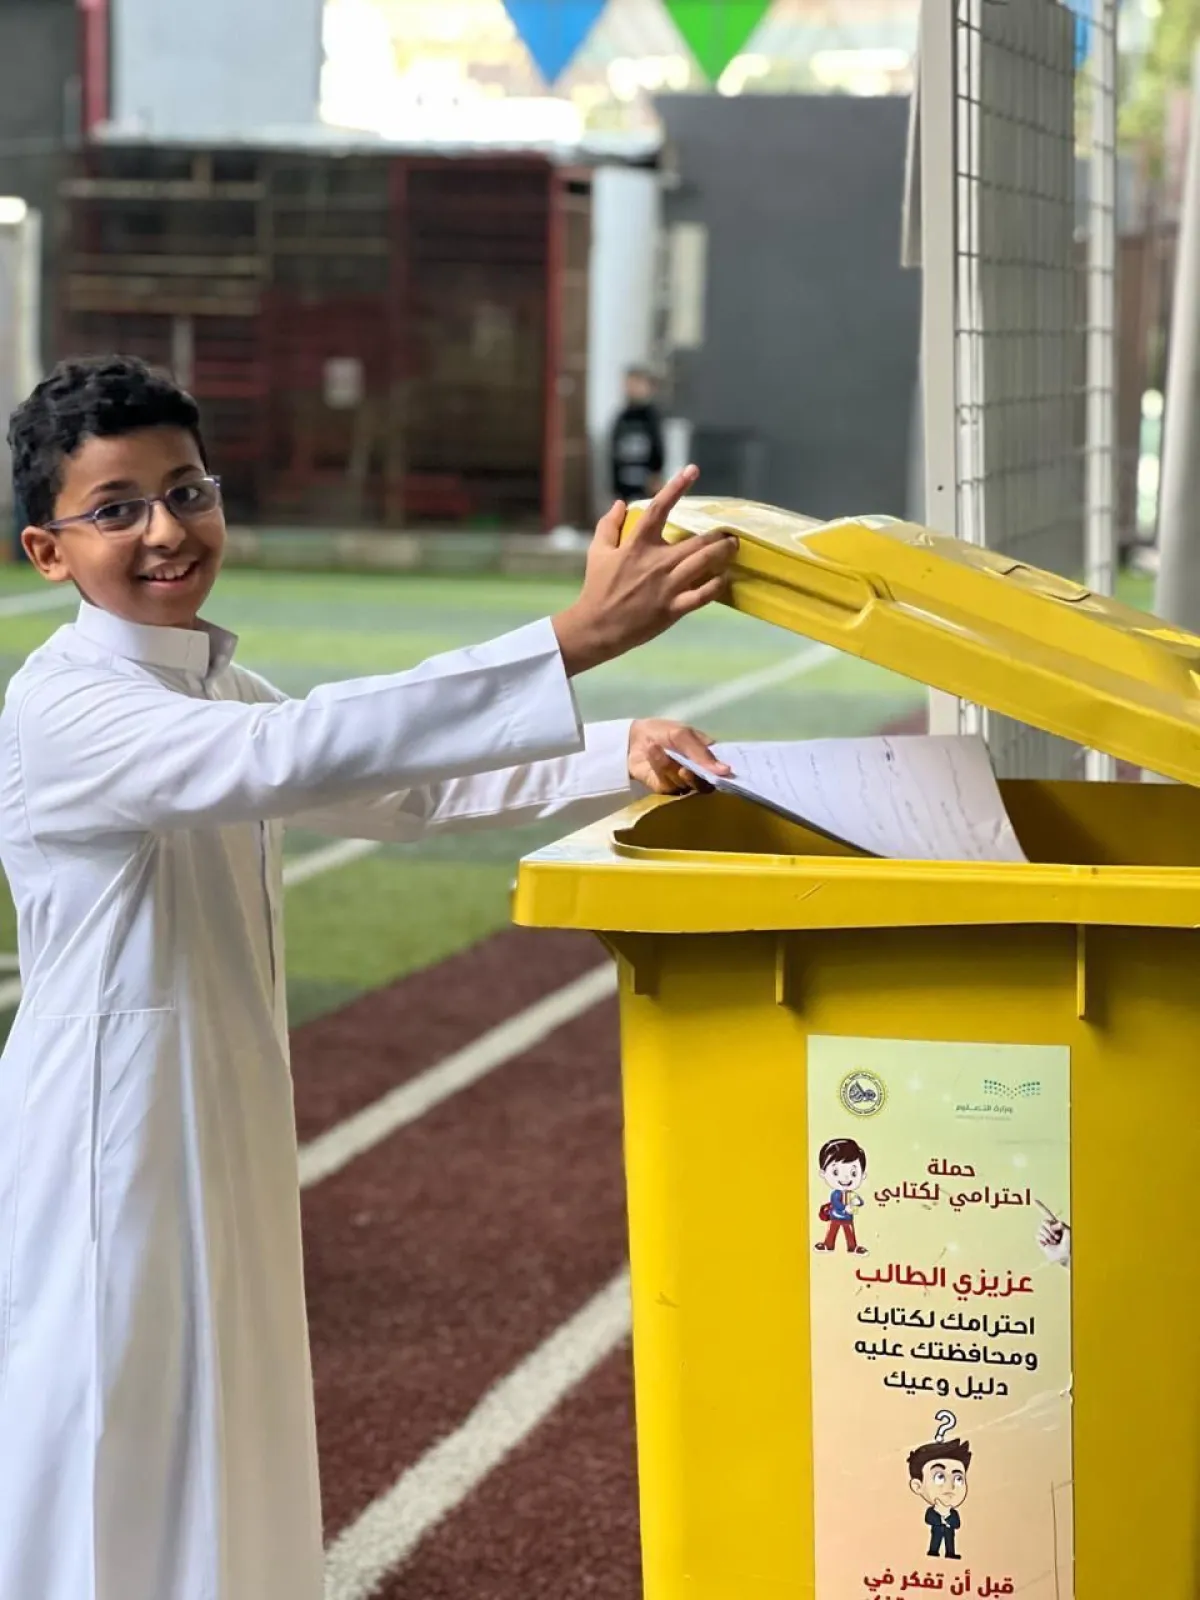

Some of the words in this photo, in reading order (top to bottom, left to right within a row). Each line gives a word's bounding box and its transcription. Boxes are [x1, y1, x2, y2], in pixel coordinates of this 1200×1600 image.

[927, 1158, 975, 1178] حملة
[874, 1181, 940, 1207] لكتابي
[949, 1186, 1031, 1213] احترامي
[855, 1263, 946, 1289] الطالب
[952, 1269, 1034, 1302] عزيزي
[857, 1306, 935, 1330] لكتابك
[940, 1312, 1035, 1337] احترامك
[854, 1338, 904, 1361] عليه
[910, 1341, 1038, 1371] ومحافظتك
[884, 1370, 949, 1396] وعيك
[955, 1375, 1008, 1400] دليل
[863, 1568, 895, 1592] في
[900, 1570, 944, 1591] تفكر
[950, 1569, 971, 1596] أن
[977, 1576, 1014, 1599] قبل
